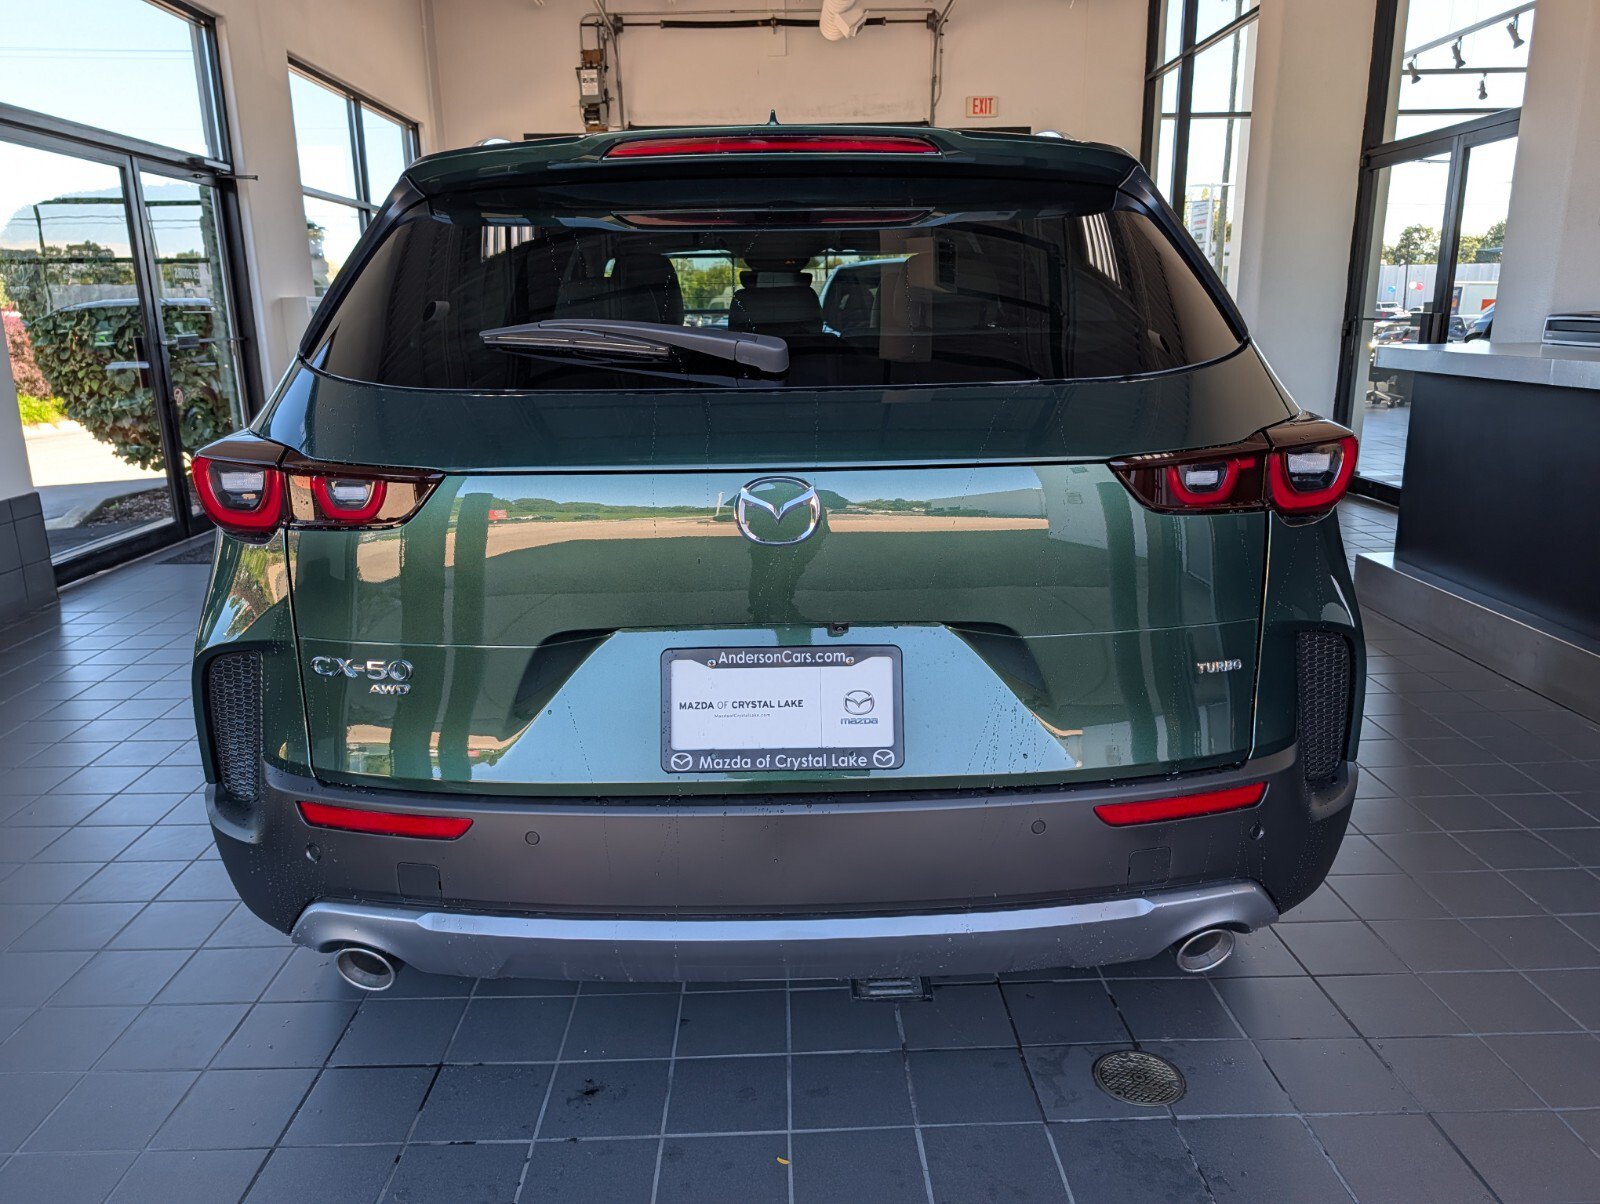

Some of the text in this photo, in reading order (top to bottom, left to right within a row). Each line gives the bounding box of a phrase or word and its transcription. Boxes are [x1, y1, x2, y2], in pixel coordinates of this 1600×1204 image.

[972, 97, 994, 115] EXIT
[718, 650, 846, 664] AndersonCars.com
[310, 656, 413, 681] CX-50
[1197, 659, 1242, 674] TURBO
[369, 684, 411, 695] AWD
[679, 699, 804, 710] MAZDA OF CRYSTAL LAKE
[699, 752, 868, 770] Mazda of Crystal Lake
